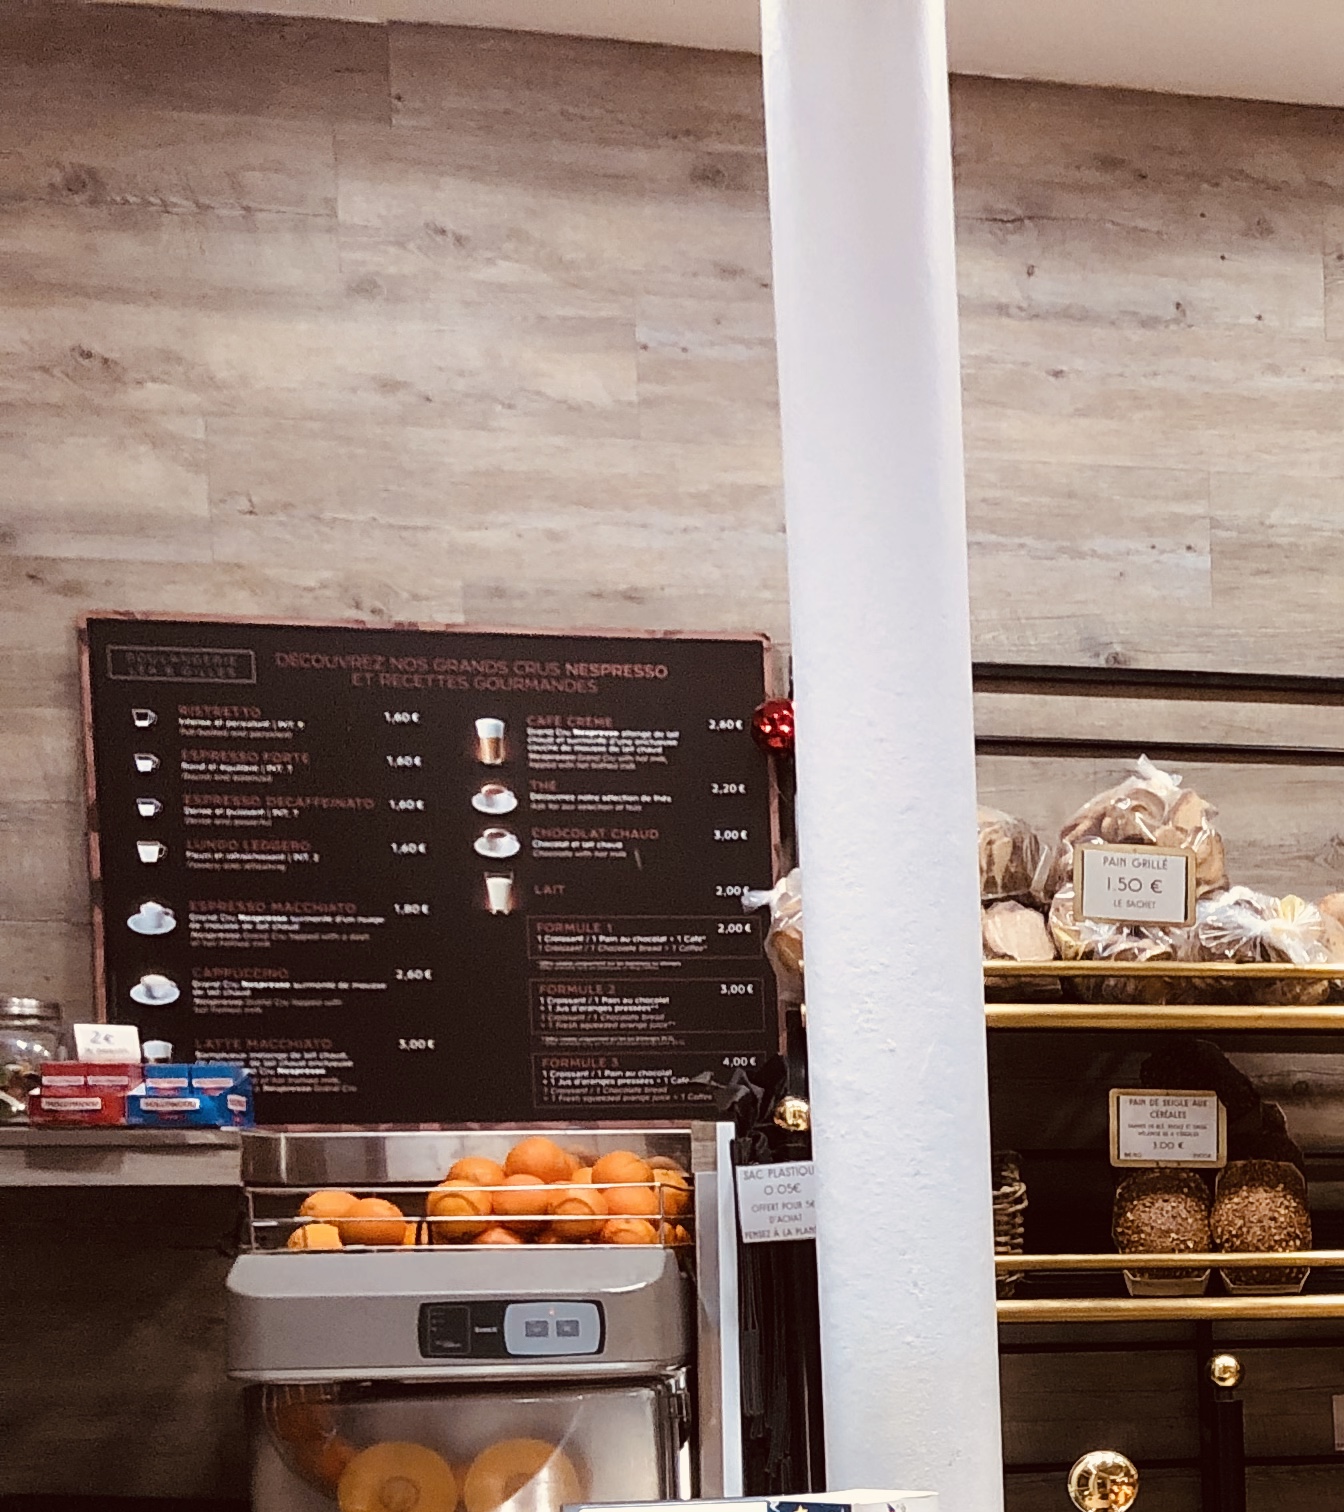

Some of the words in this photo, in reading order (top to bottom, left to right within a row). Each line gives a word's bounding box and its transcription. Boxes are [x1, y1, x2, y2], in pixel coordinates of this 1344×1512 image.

[391, 657, 428, 672] NOS
[433, 658, 507, 675] GRANDS
[513, 660, 560, 677] CRUS
[565, 661, 669, 679] NESPRESSO
[352, 672, 371, 686] ET
[380, 673, 468, 690] RECETTES
[475, 677, 598, 694] GOURMANDES
[611, 829, 659, 839] CHAUD
[1103, 856, 1126, 867] PAIN
[1132, 858, 1168, 870] GRILLÉ
[534, 885, 566, 895] LAIT
[1151, 880, 1162, 893] €
[1126, 900, 1156, 909] SACHET
[536, 923, 601, 933] FORMULE
[607, 923, 613, 933] 1
[718, 923, 743, 934] 2,00
[539, 984, 603, 995] FORMULE
[720, 984, 745, 995] 3,00
[542, 1058, 606, 1068] FORMULE
[723, 1057, 748, 1067] 4,00
[744, 1170, 763, 1180] SAC
[768, 1165, 815, 1178] PLASTIQU
[752, 1202, 778, 1213] OFFERT
[782, 1201, 802, 1210] POUR
